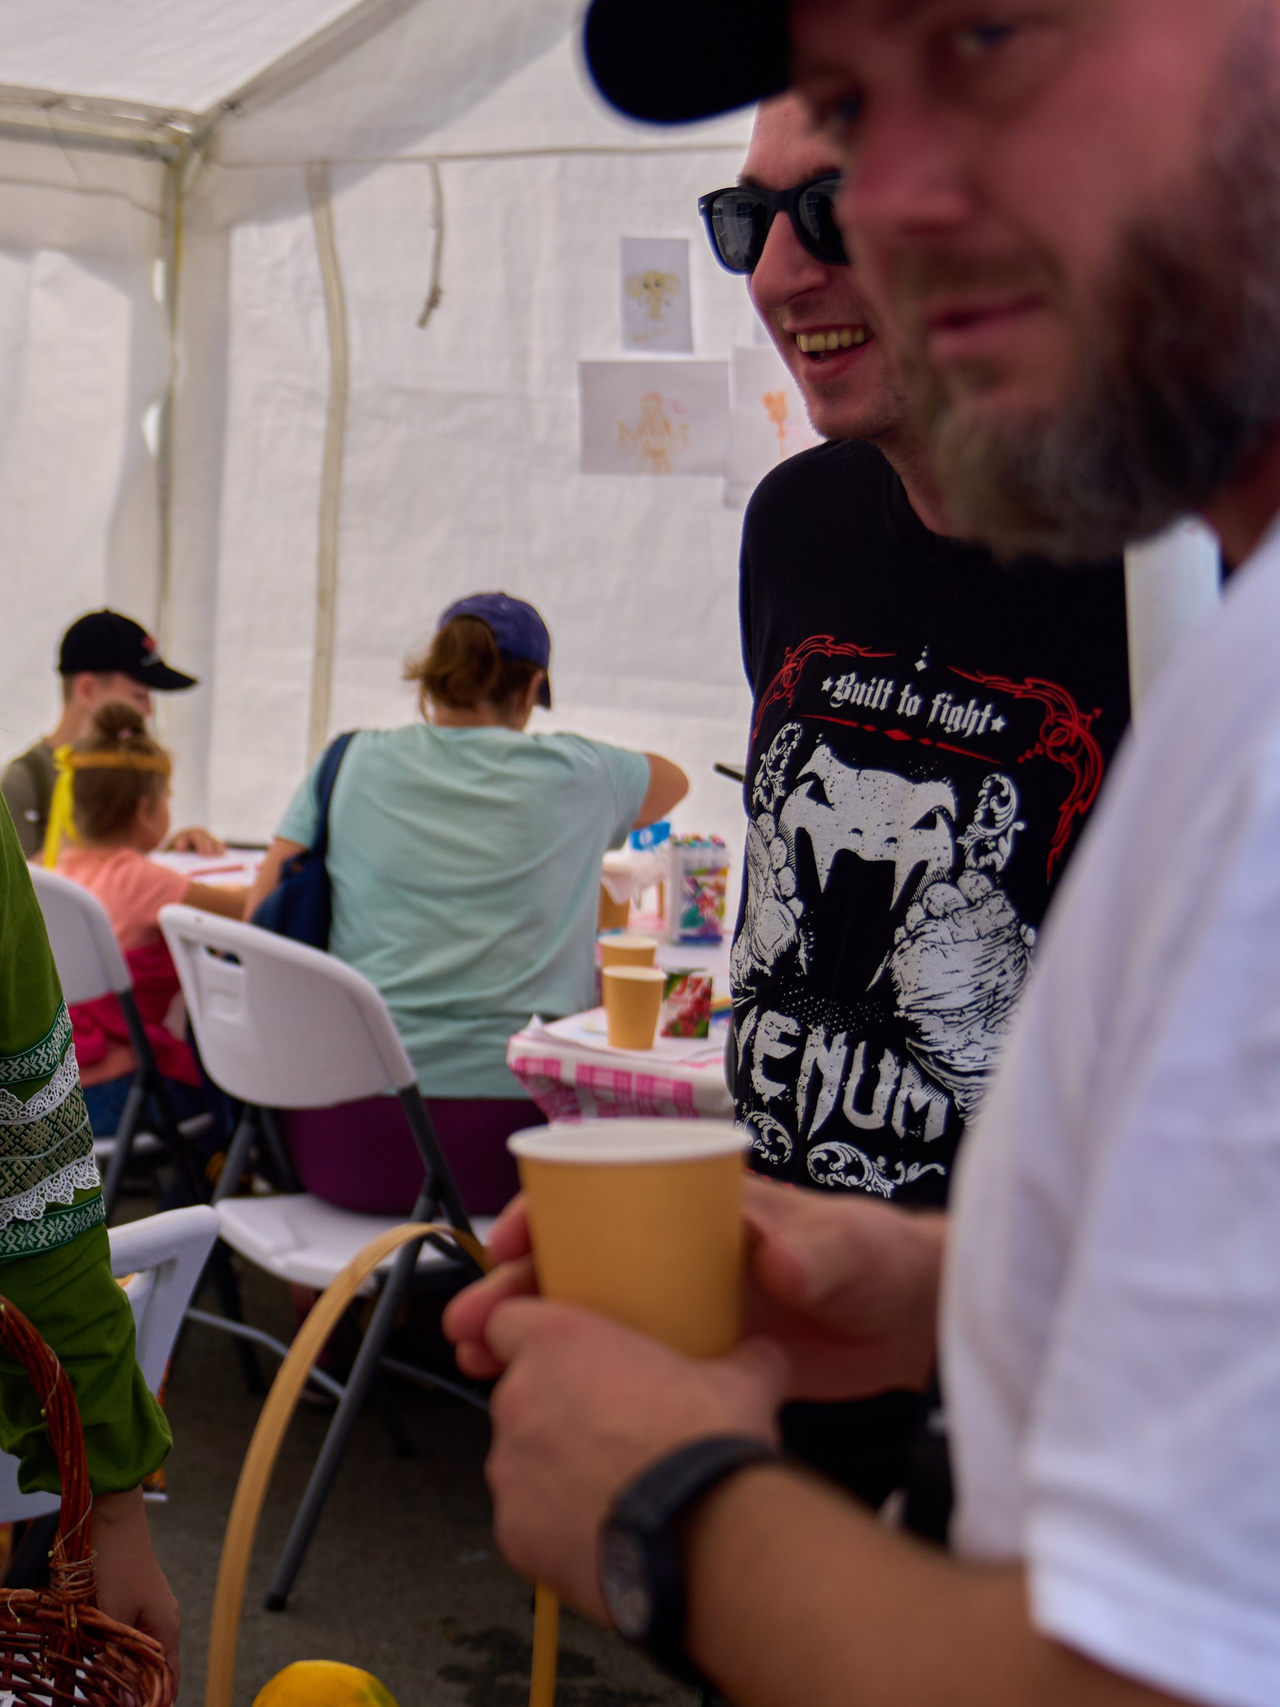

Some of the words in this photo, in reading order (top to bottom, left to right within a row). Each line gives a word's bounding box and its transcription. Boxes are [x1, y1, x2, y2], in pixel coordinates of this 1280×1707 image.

[829, 672, 893, 710] Built
[896, 684, 921, 717] to
[926, 692, 992, 738] fight
